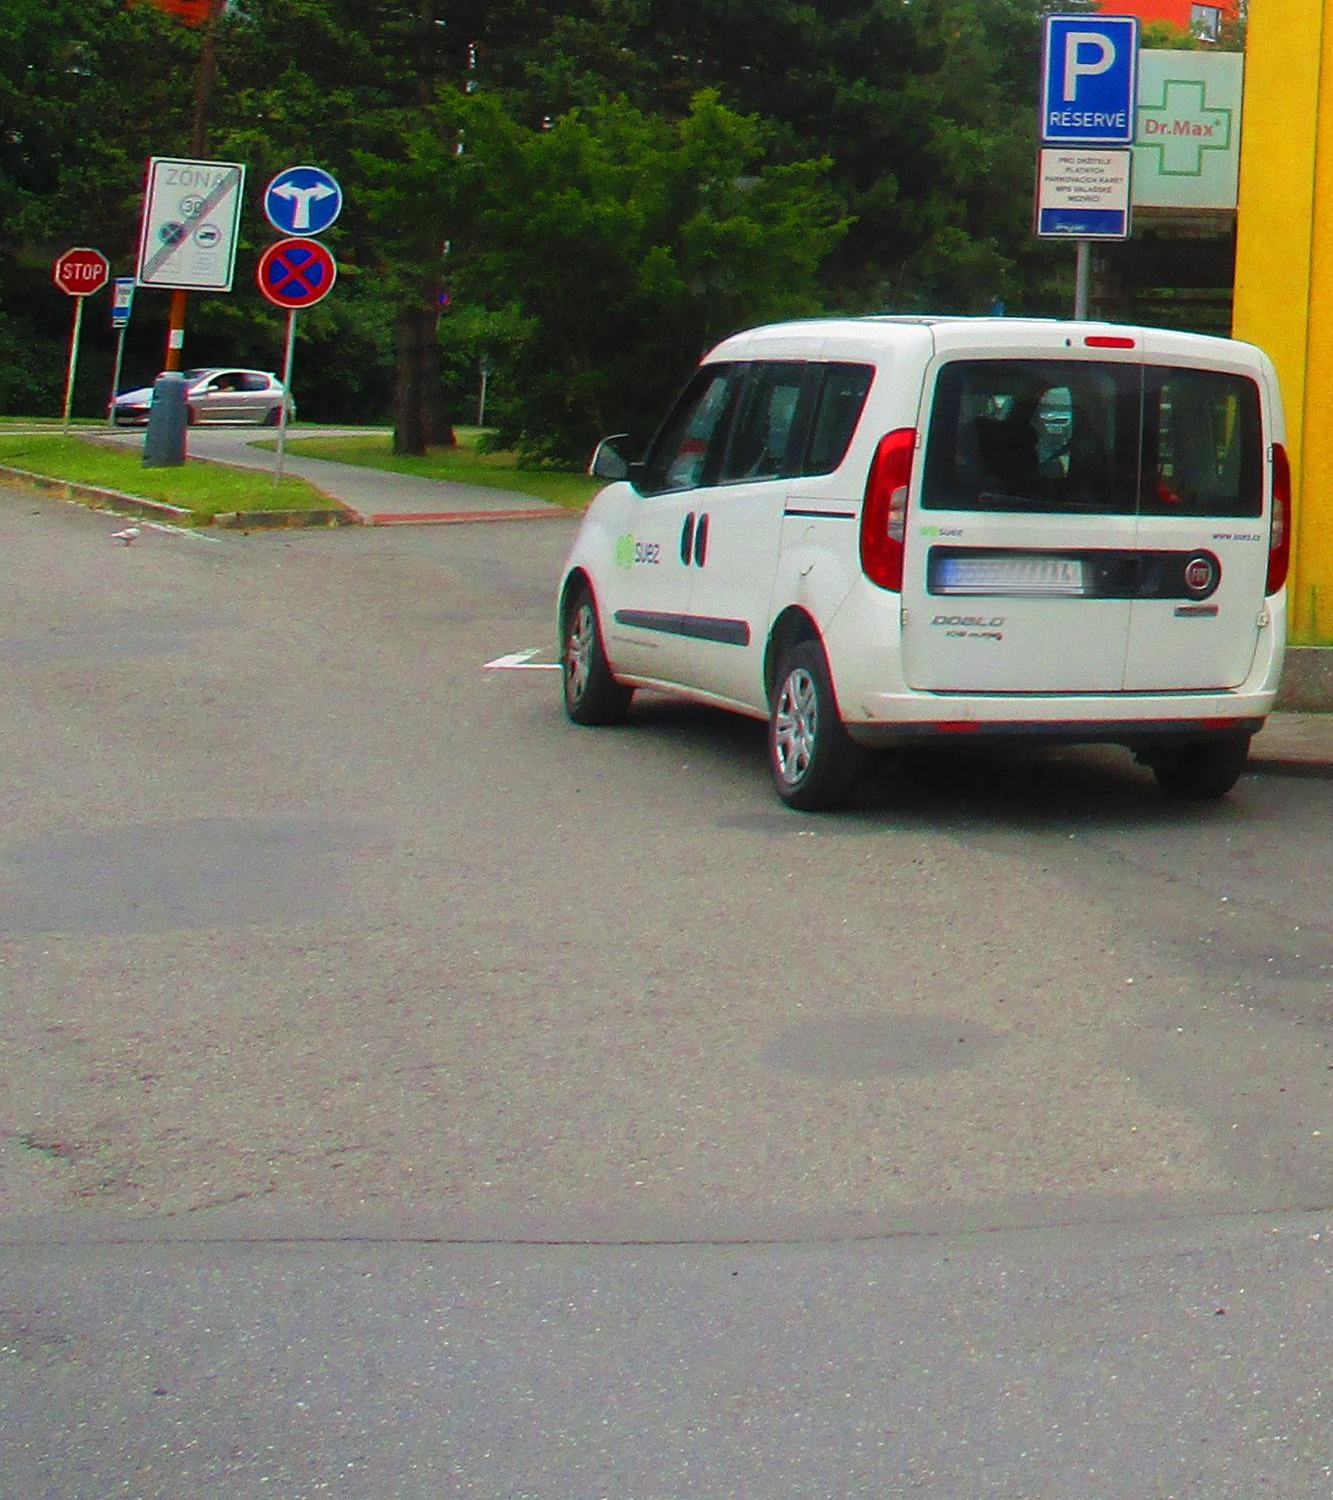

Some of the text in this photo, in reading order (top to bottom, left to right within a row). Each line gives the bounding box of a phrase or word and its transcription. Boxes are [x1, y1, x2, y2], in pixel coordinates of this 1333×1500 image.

[1063, 31, 1116, 102] P
[1049, 107, 1126, 128] RÉSERVÉ
[1145, 118, 1214, 137] Dr.Max
[62, 262, 103, 280] STOP
